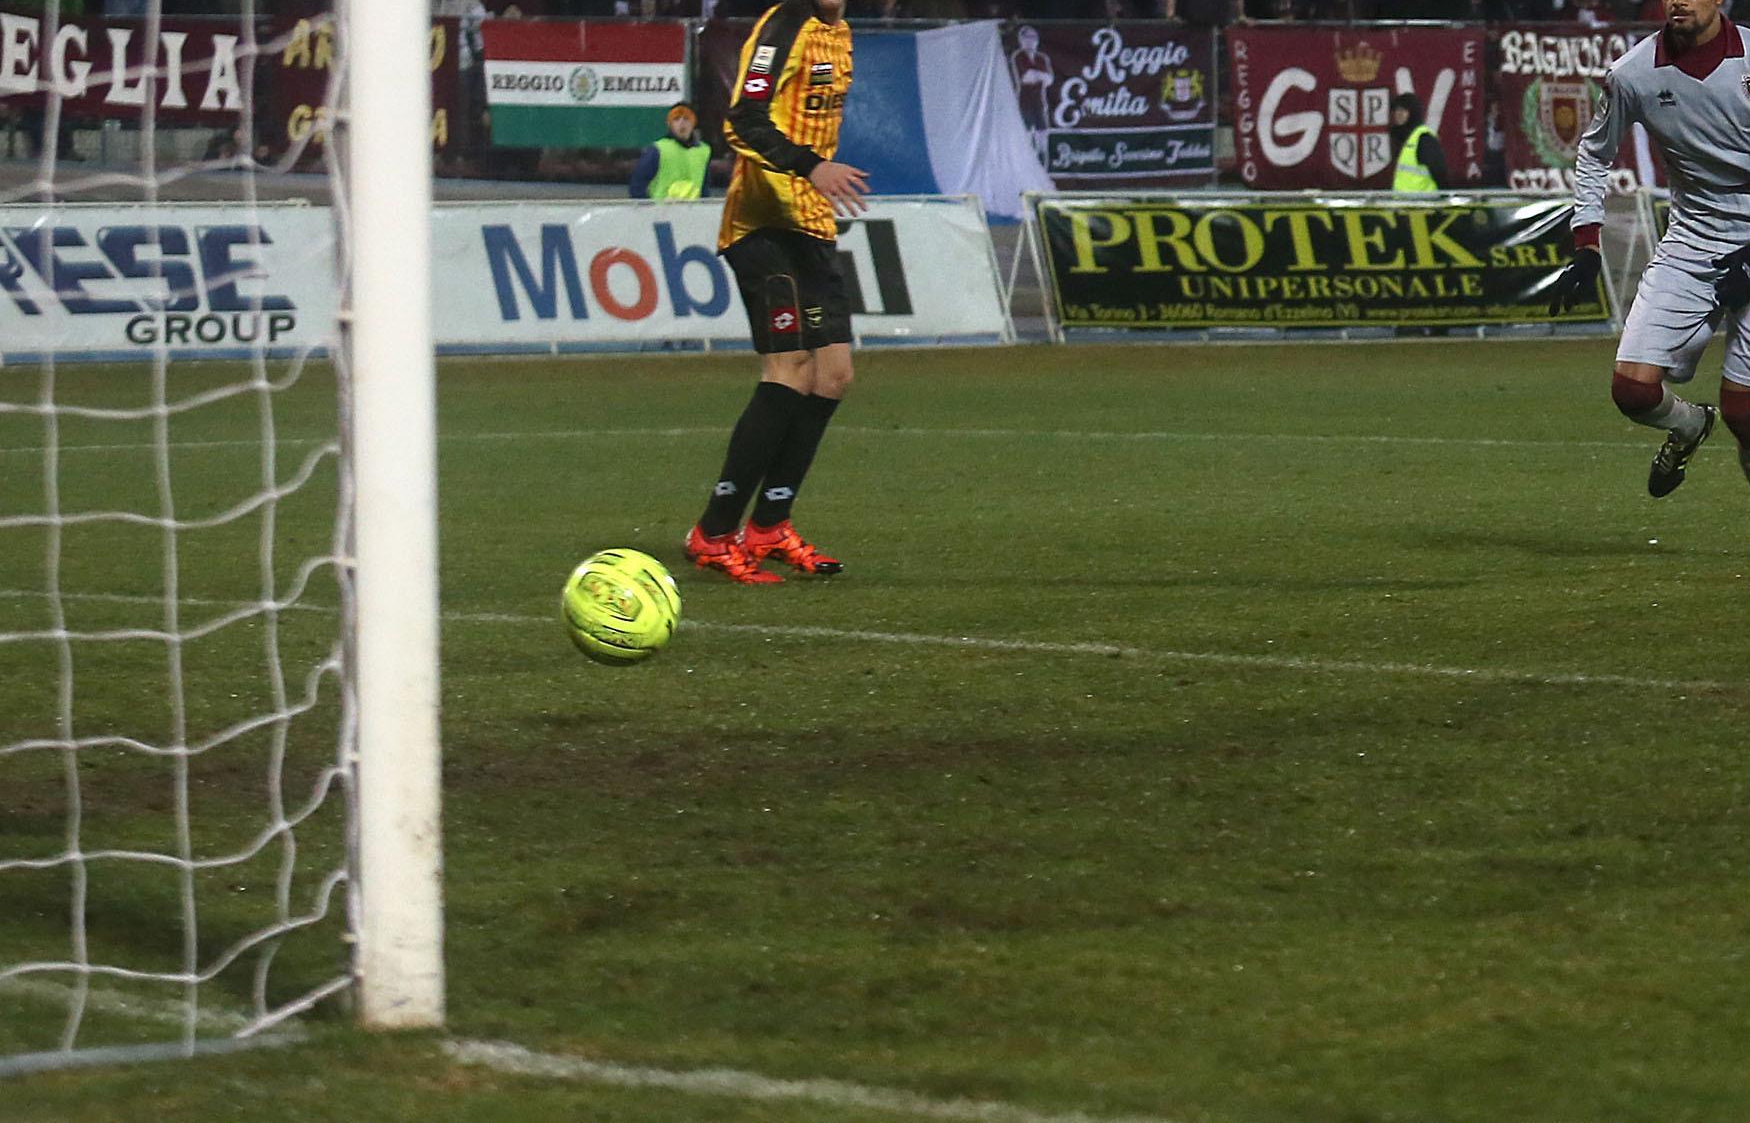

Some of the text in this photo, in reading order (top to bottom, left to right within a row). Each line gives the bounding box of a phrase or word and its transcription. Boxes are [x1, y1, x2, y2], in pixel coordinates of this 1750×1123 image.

[492, 74, 680, 91] REGGIO EMILIA
[1083, 27, 1189, 84] Reggio
[1055, 77, 1149, 128] Emilia
[1234, 40, 1257, 182] REGGIO
[1257, 67, 1324, 166] G
[1463, 40, 1482, 179] EMILIA
[482, 221, 731, 321] Mob
[1067, 208, 1487, 274] PROTEK
[1180, 274, 1484, 300] UNIPERSONALE
[125, 315, 296, 345] GROUP
